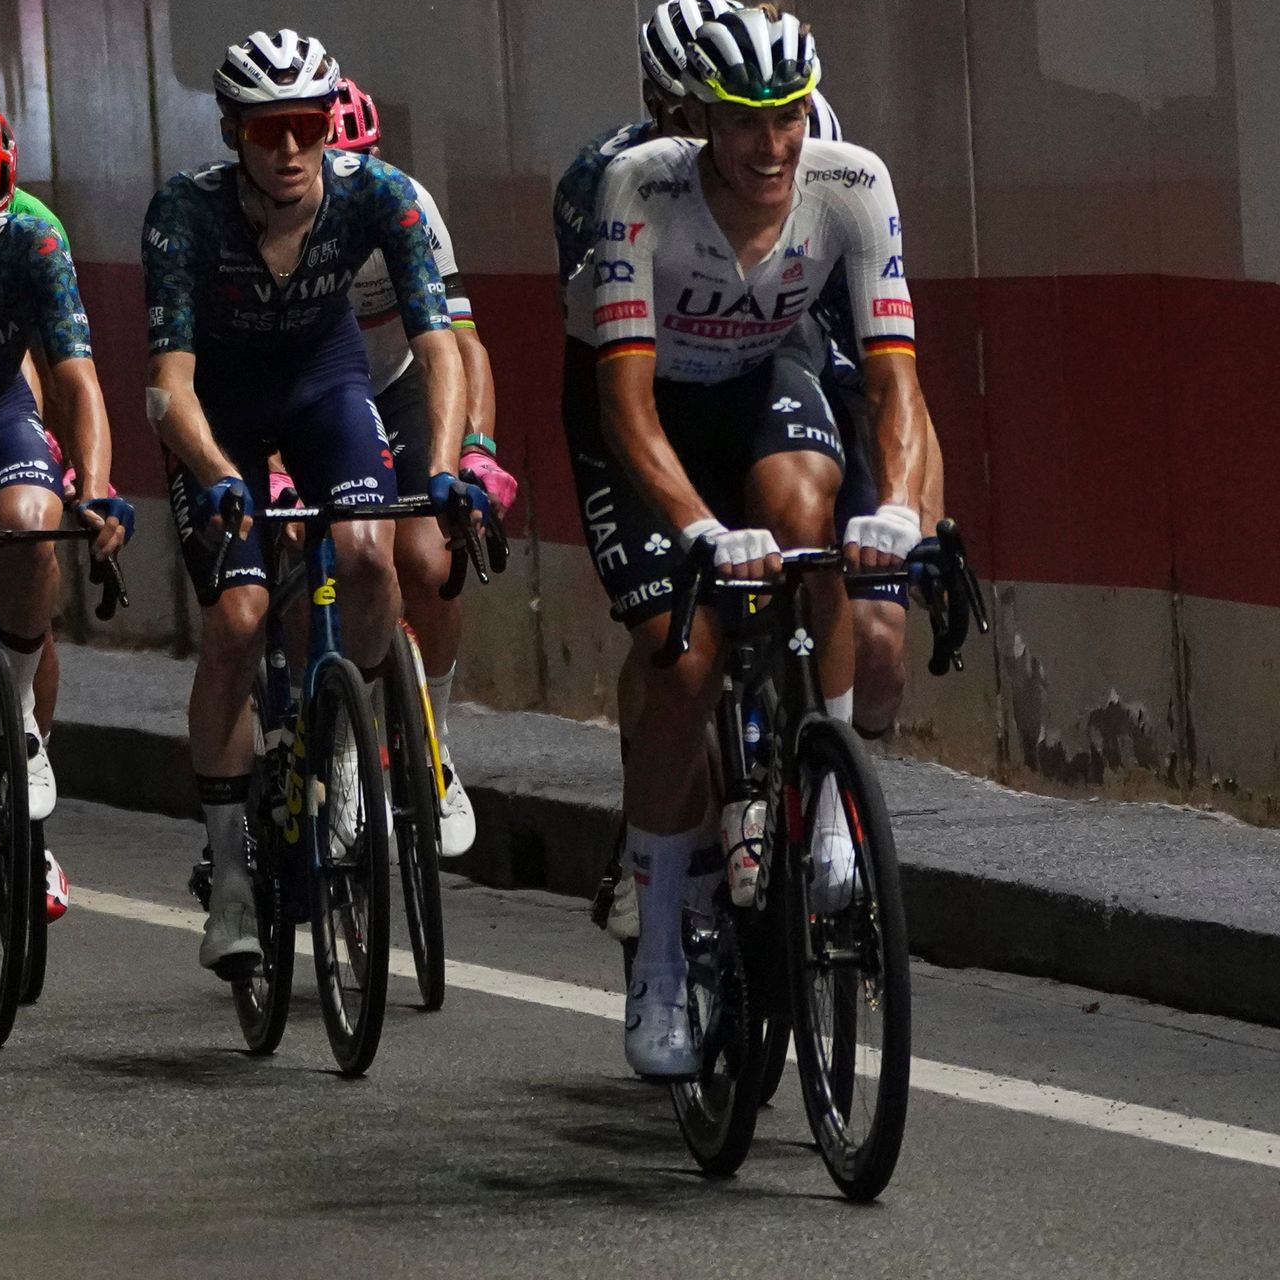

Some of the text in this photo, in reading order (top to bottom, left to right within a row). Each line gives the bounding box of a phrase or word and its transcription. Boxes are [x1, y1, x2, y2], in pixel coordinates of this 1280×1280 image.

[805, 167, 877, 189] presight
[677, 286, 809, 321] UAE
[0, 471, 55, 484] BETCITY
[330, 479, 363, 496] AGU
[585, 486, 628, 577] UAE
